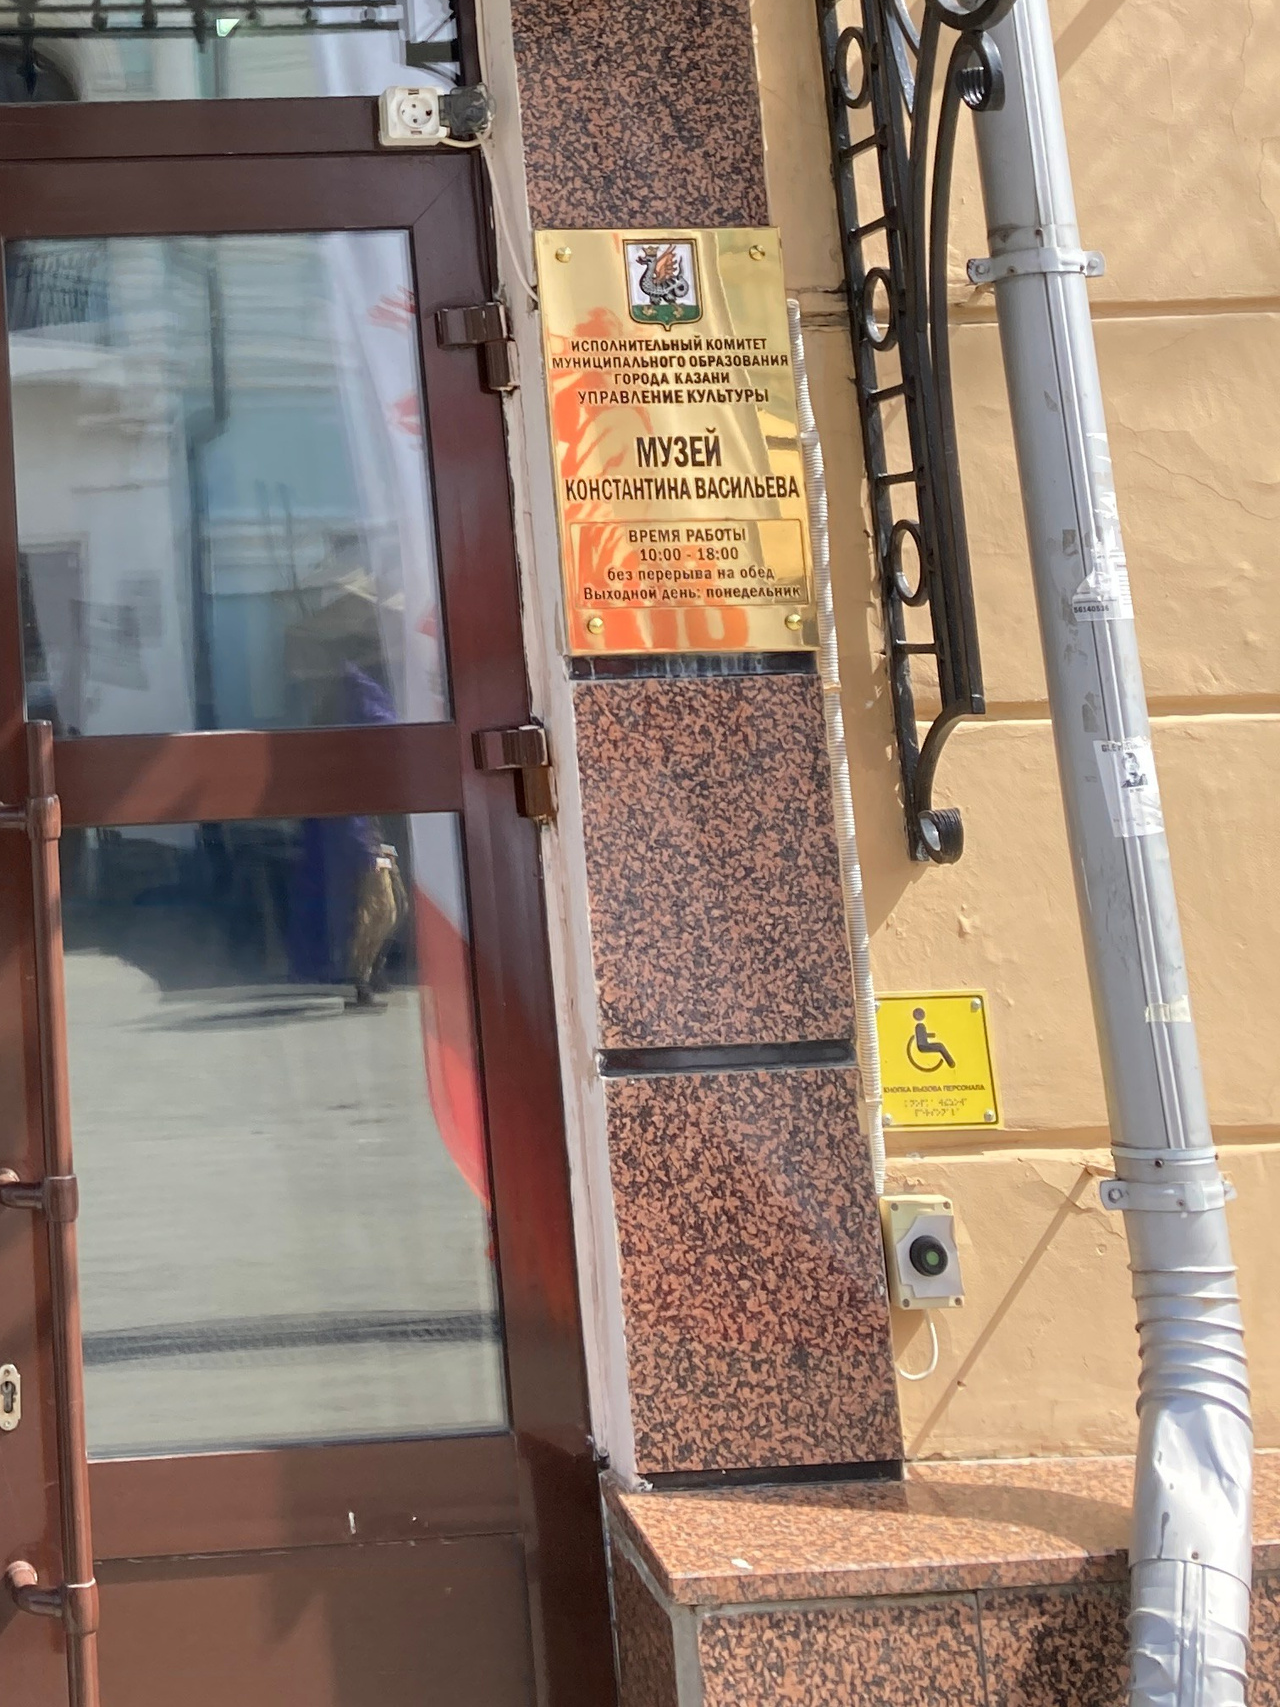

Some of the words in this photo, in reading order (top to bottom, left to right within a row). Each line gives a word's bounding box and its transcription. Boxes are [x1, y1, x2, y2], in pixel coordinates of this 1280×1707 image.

[571, 336, 702, 352] ИСПОЛНИТЕЛЬНЫЙ
[706, 338, 767, 351] КОМИТЕТ
[552, 356, 686, 369] МУНИЦИПАЛЬНОГО
[689, 354, 788, 368] ОБРАЗОВАНИЯ
[614, 373, 669, 386] ГОРОДА
[675, 372, 730, 384] КАЗАНИ
[578, 391, 684, 404] УПРАВЛЕНИЕ
[688, 389, 769, 403] КУЛЬТУРЫ
[636, 428, 722, 468] МУЗЕЙ
[566, 477, 691, 501] КОНСТАНТИНА
[695, 476, 800, 499] ВАСИЛЬЕВА
[629, 529, 681, 543] ВРЕМЯ
[686, 528, 746, 542] РАБОТЫ
[640, 548, 681, 561] 10:00
[698, 547, 739, 560] 18:00
[608, 568, 633, 581] без
[638, 569, 712, 583] перерыва
[717, 568, 735, 579] на
[740, 565, 775, 580] обед
[584, 585, 657, 601] Выходной
[662, 586, 701, 600] день:
[706, 585, 800, 599] понедельник
[943, 1084, 985, 1092] ПЕРСОНАЛА
